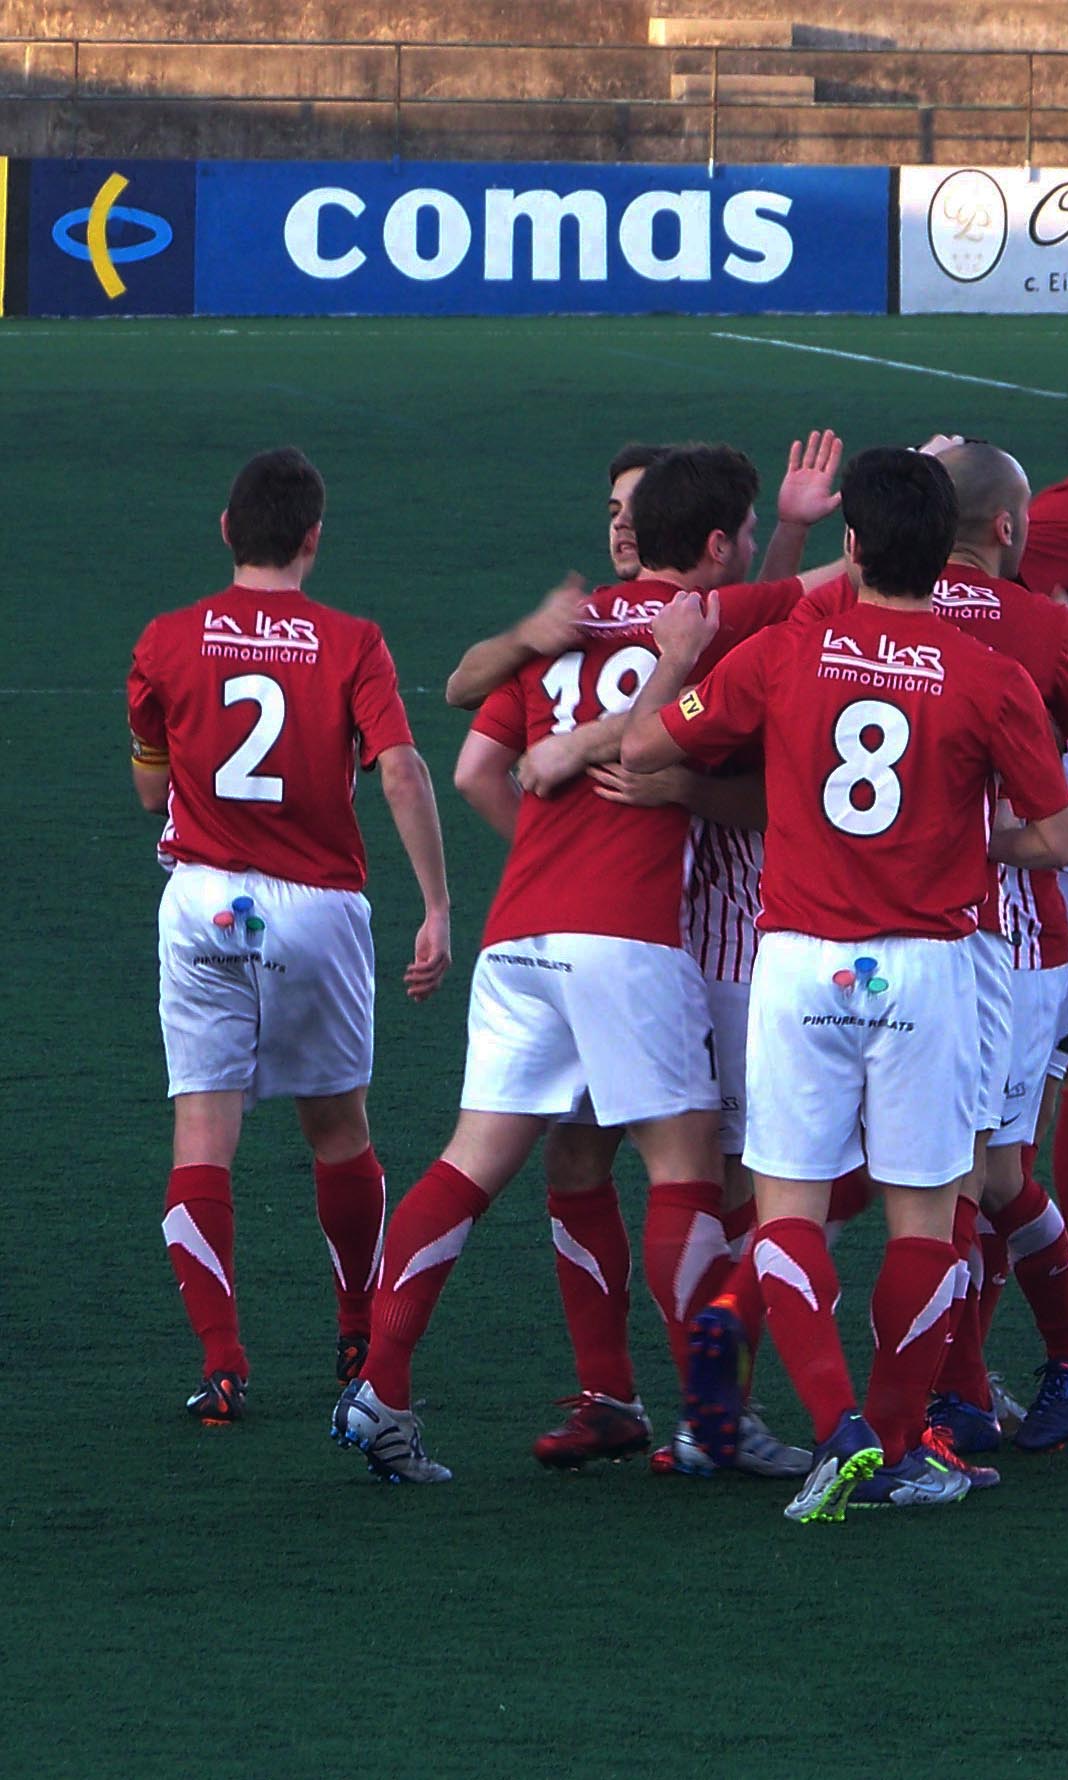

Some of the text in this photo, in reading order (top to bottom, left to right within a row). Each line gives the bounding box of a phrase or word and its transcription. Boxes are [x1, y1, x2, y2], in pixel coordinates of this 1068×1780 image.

[284, 187, 794, 283] comas
[214, 673, 286, 803] 2
[682, 693, 700, 715] TV
[822, 698, 912, 837] 8
[802, 1015, 866, 1027] PINTURES
